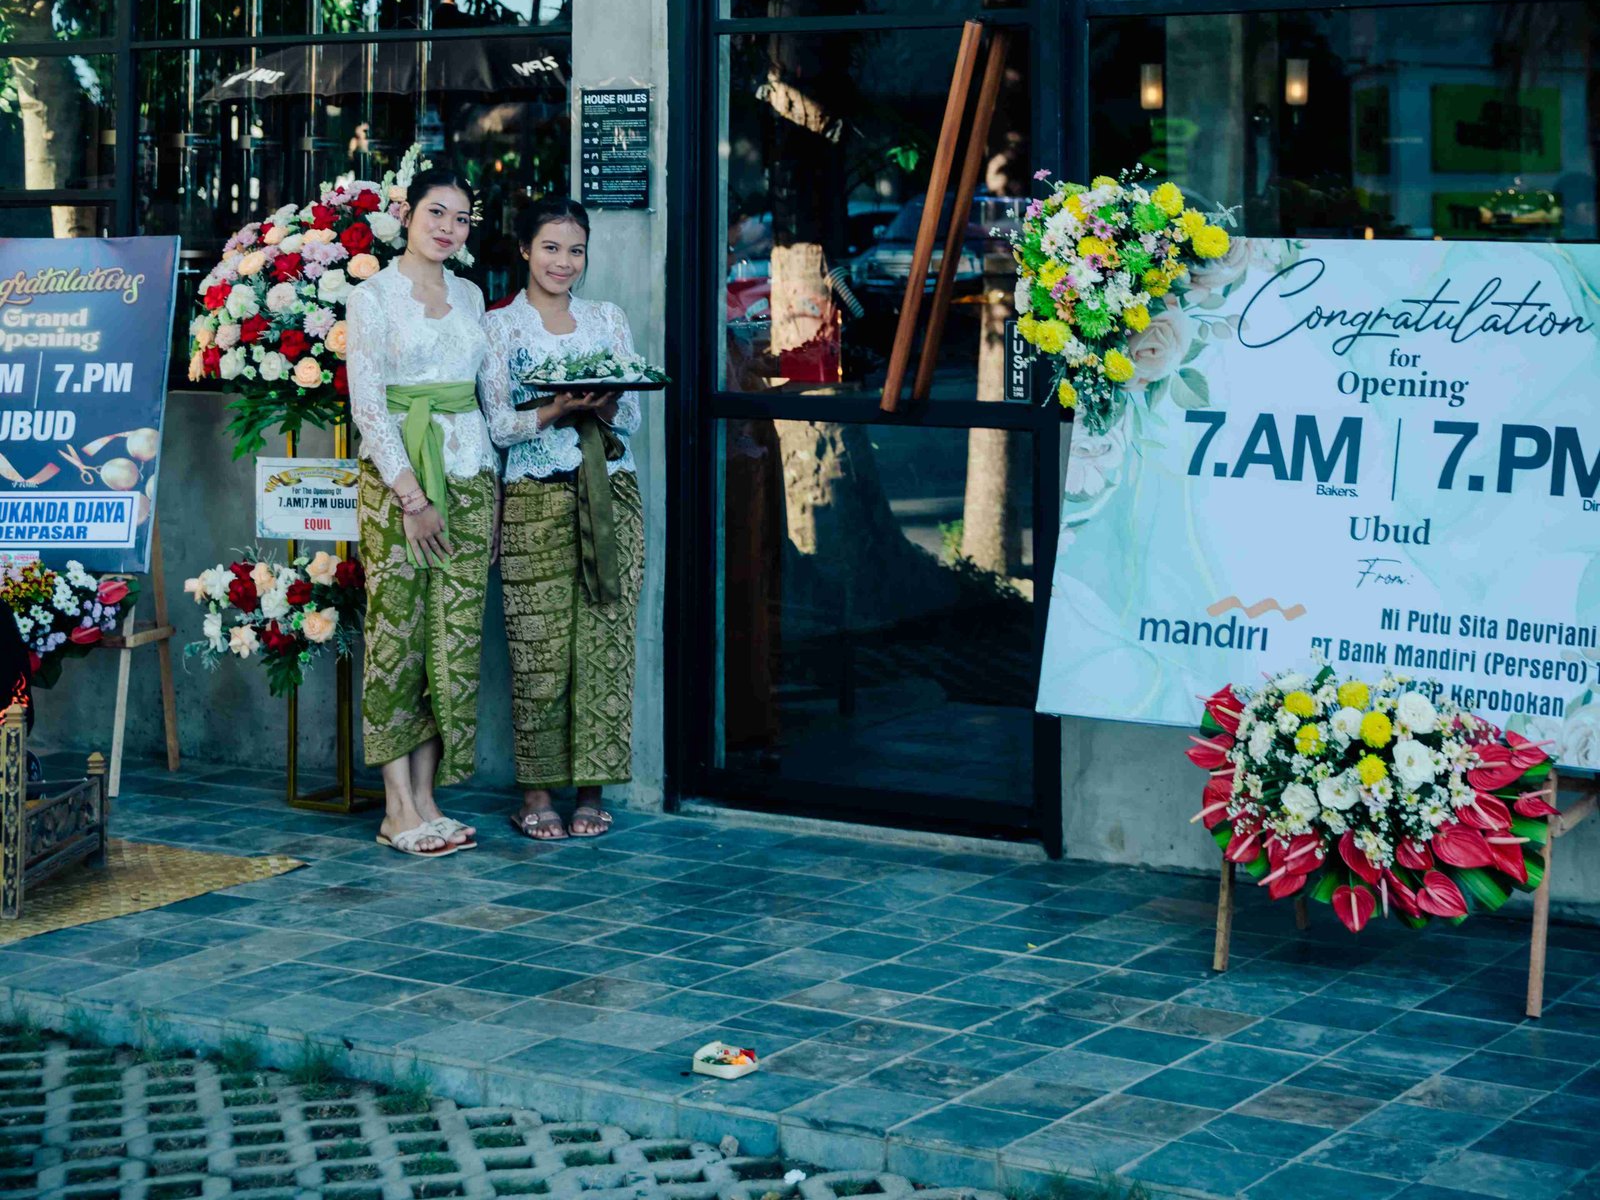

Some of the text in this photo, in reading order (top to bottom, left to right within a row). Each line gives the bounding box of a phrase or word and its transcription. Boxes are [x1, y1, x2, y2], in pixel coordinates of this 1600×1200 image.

[584, 93, 647, 105] HOUSE RULES
[3, 307, 88, 327] Grand
[1238, 258, 1594, 356] Congratulation
[1389, 347, 1421, 368] for
[54, 363, 133, 393] 7.PM
[1337, 371, 1469, 407] Opening
[1184, 409, 1363, 484] 7.AM
[1316, 483, 1358, 498] Bakers.
[74, 501, 125, 523] DJAYA
[304, 518, 332, 531] EQUIL
[1349, 515, 1431, 546] Ubud
[1139, 615, 1268, 651] mandiri
[1380, 608, 1597, 648] Ni Putu Sita Devriani
[1338, 639, 1387, 665] Bank
[1394, 644, 1476, 673] Mandiri
[1484, 652, 1588, 684] (Persero)
[1450, 684, 1564, 717] Kerobokan
